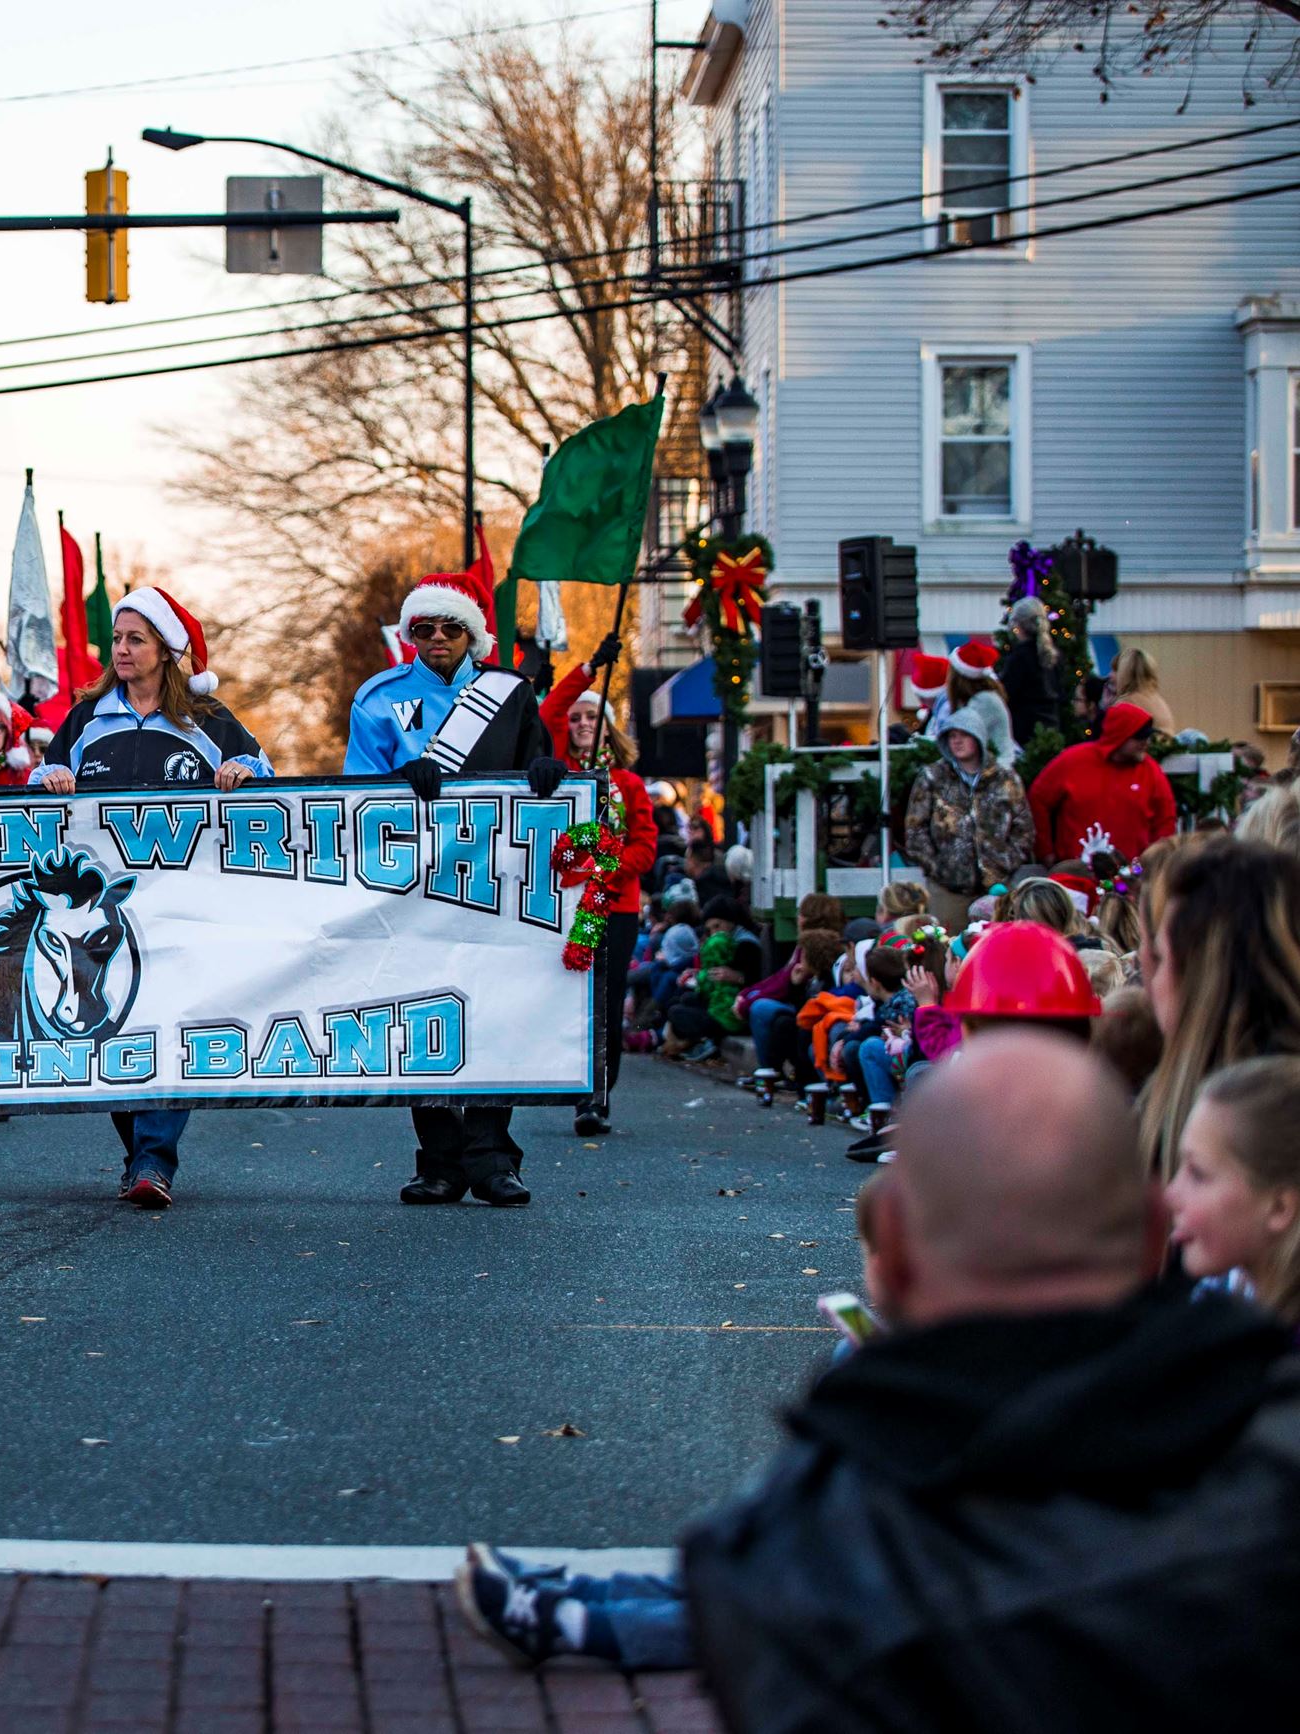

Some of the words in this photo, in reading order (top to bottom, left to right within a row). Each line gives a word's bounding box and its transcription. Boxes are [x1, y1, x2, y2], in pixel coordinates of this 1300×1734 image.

[391, 697, 424, 732] W
[99, 794, 576, 934] WRIGHT
[180, 991, 466, 1080] BAND
